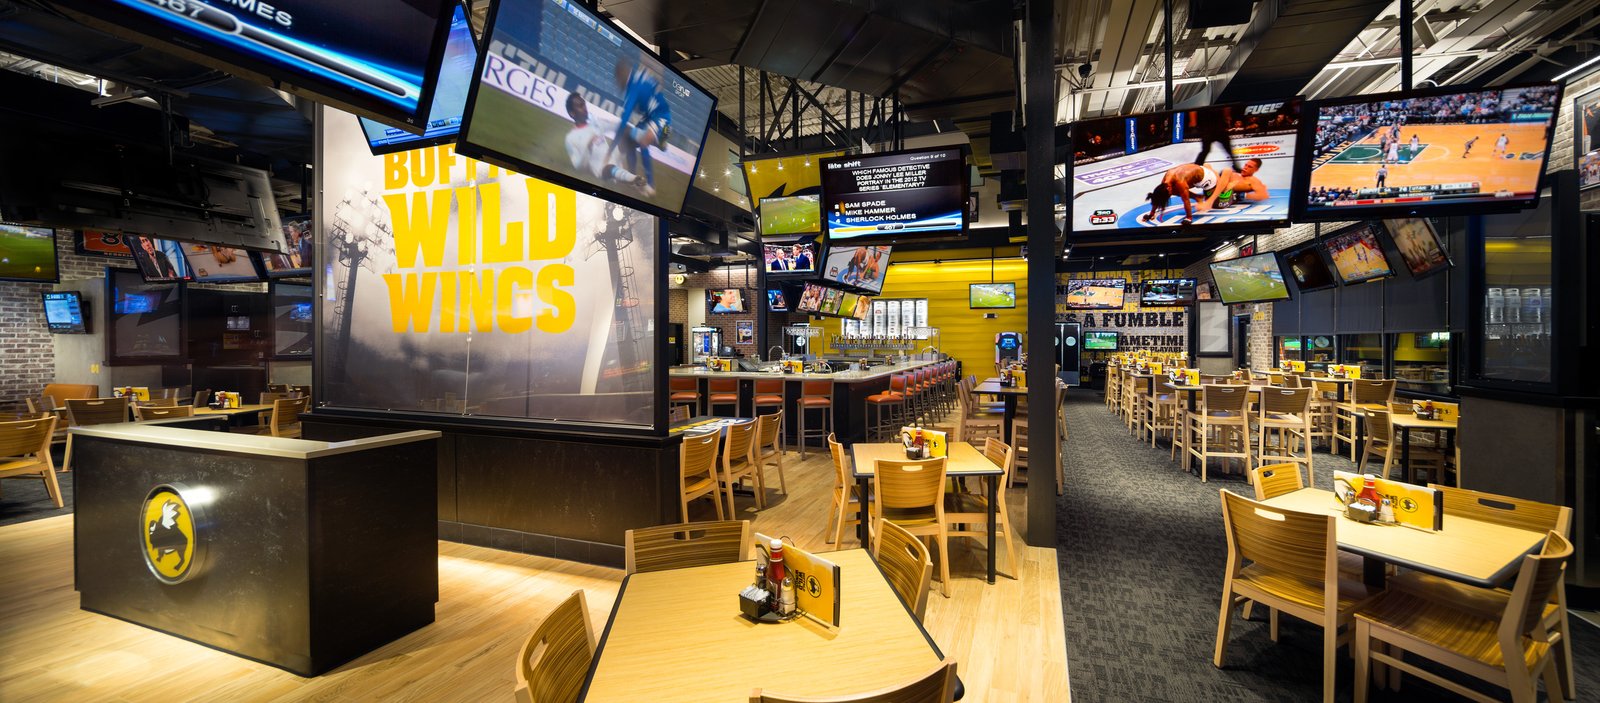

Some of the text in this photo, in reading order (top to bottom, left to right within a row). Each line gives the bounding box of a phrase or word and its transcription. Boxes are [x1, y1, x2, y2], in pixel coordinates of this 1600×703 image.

[223, 0, 293, 26] MES
[843, 161, 862, 169] shift
[897, 163, 930, 172] DETECTIVE
[873, 172, 892, 180] JONNY
[857, 179, 883, 187] PORTRAY
[864, 207, 896, 215] HAMMER
[845, 215, 884, 223] SHERLOCK
[885, 213, 917, 221] HOLMES
[382, 177, 577, 269] WILD
[382, 264, 577, 334] WINGS
[1083, 313, 1096, 328] A
[1102, 312, 1184, 328] FUMBLE
